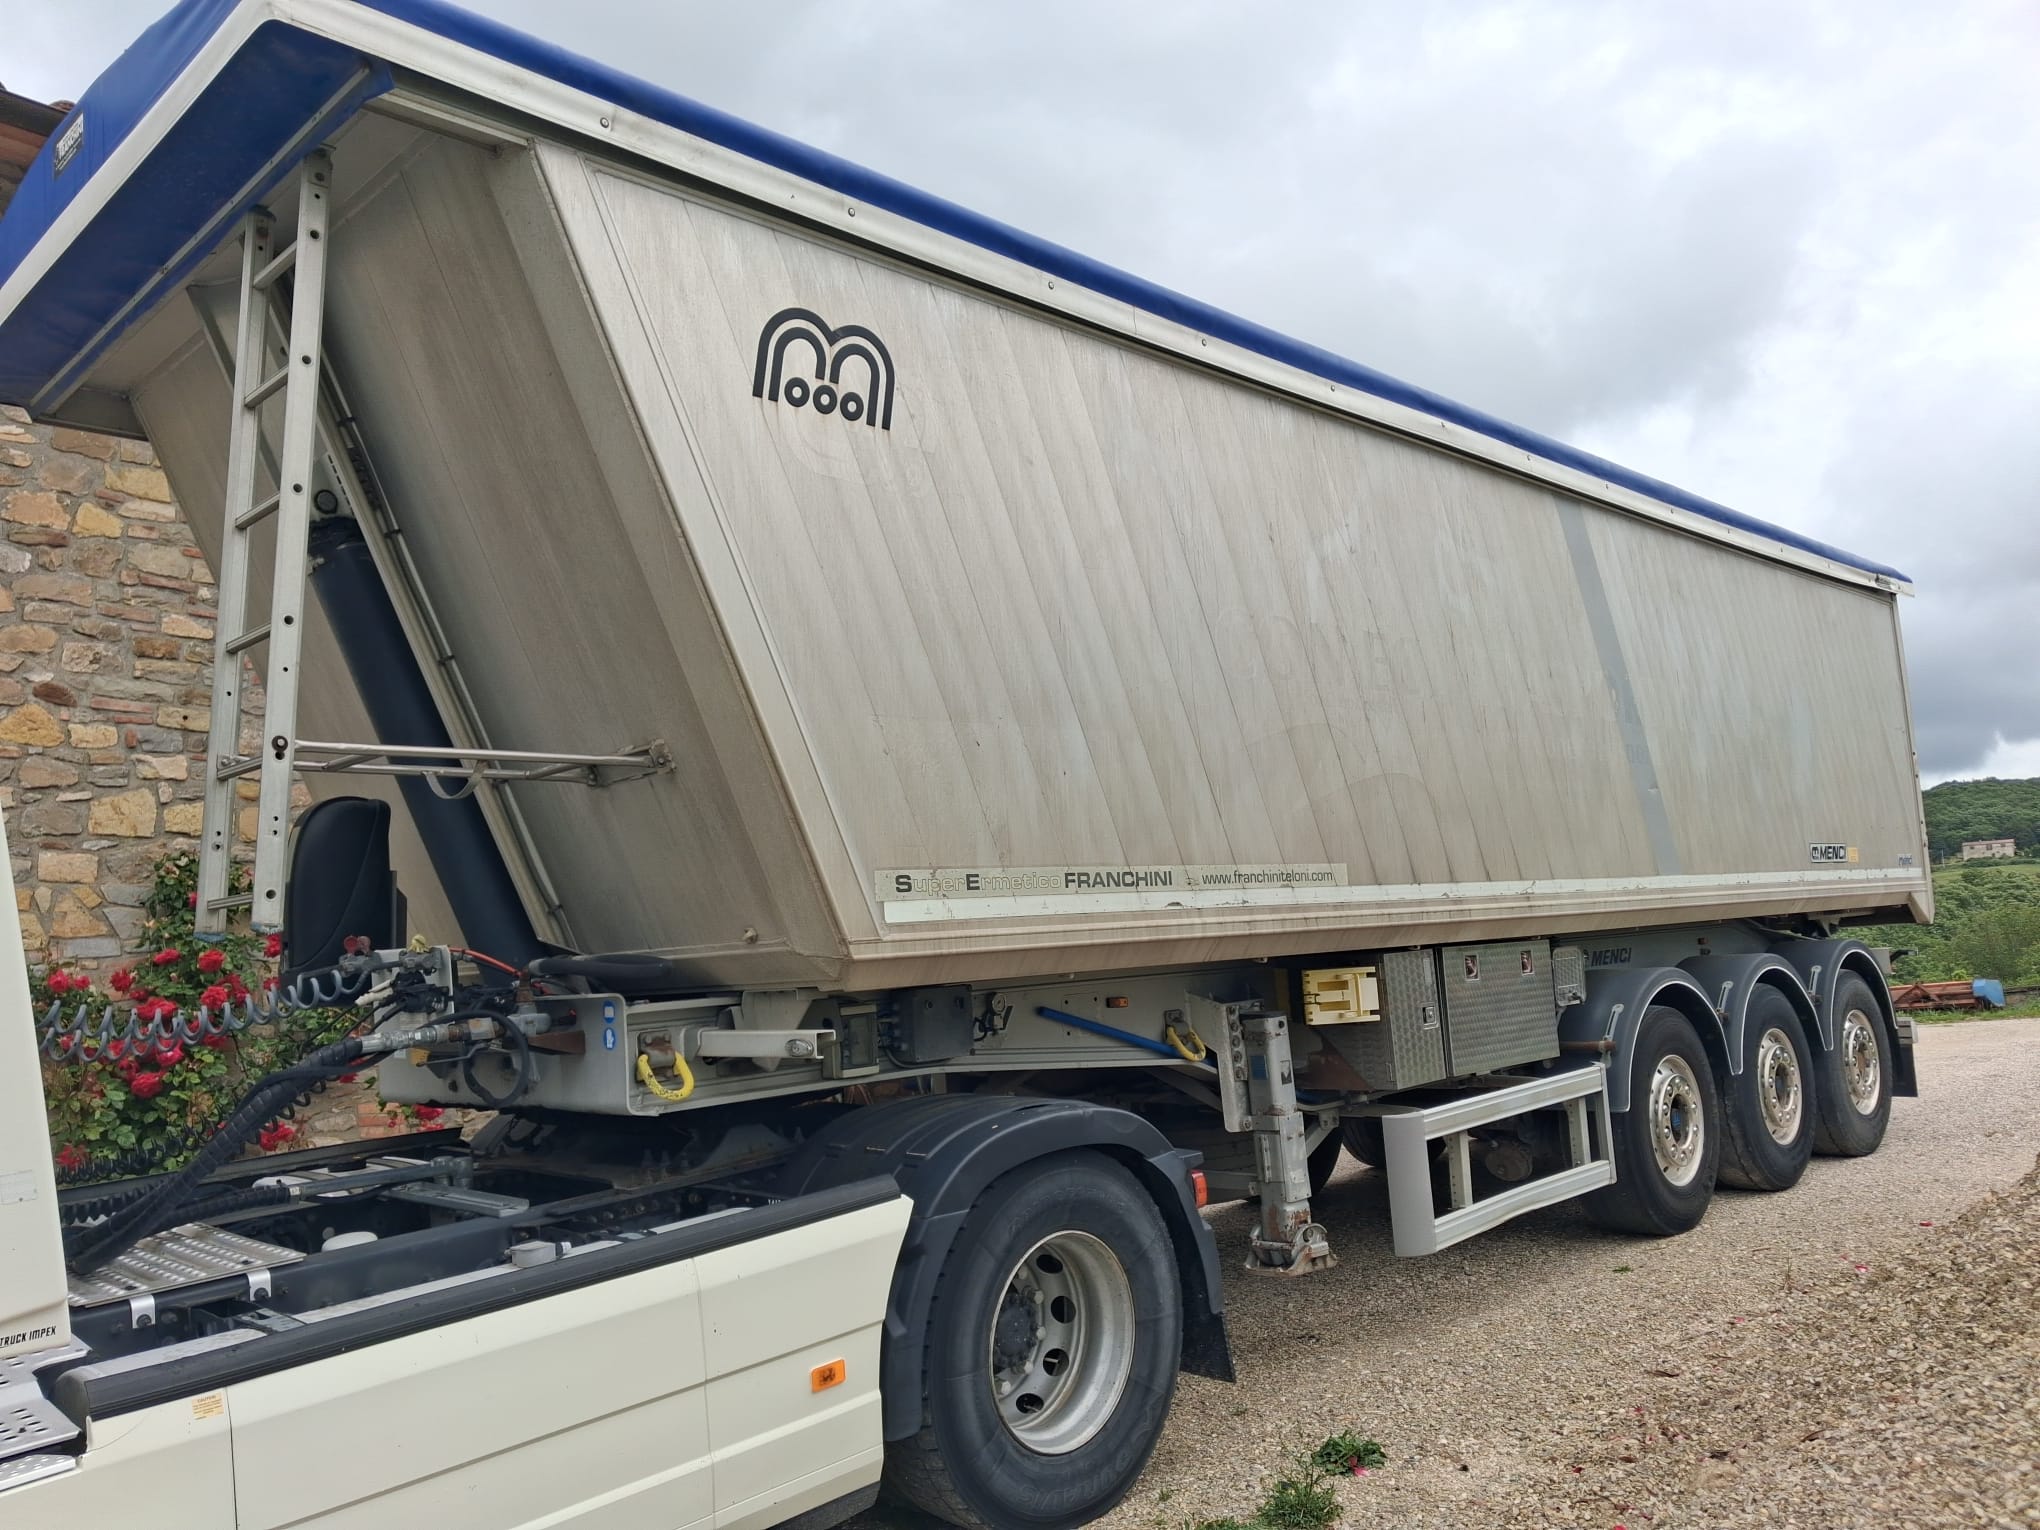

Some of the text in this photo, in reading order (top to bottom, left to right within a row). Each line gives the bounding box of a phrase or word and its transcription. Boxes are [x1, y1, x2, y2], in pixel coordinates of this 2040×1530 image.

[895, 869, 1333, 896] SuperErmetico FRANCHINI www.franchiniteloni.com
[1591, 947, 1632, 967] MENCI
[0, 1325, 56, 1346] TRUCK IMPEX
